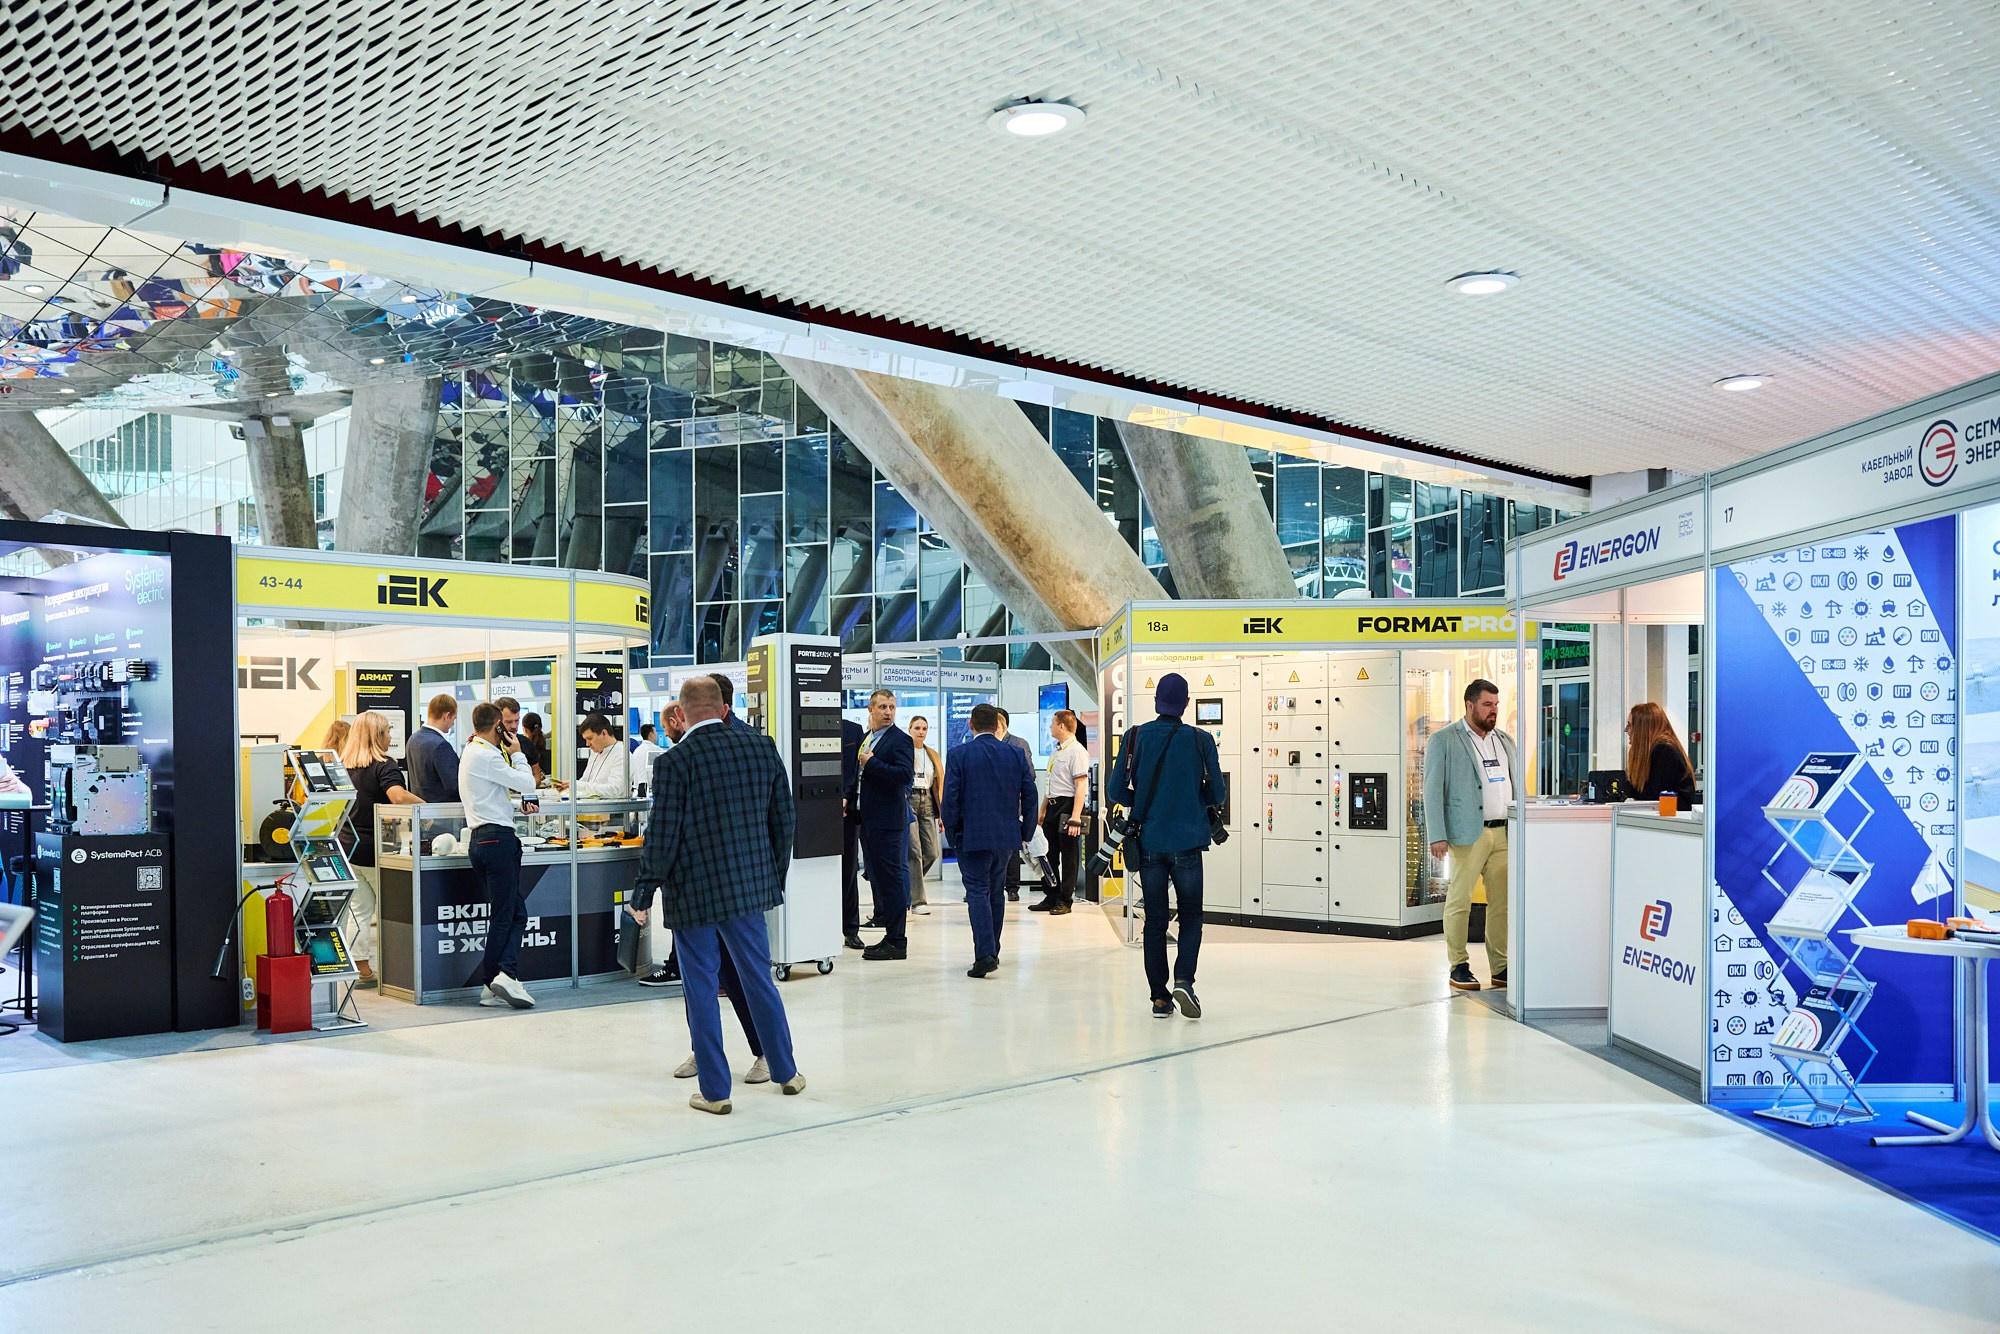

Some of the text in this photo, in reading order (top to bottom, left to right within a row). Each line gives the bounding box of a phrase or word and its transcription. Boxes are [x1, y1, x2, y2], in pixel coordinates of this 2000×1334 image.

[1861, 445, 1913, 474] КАБЕЛЬНЫЙ
[1883, 465, 1914, 483] ЗАВОД
[1724, 506, 1734, 523] 17
[1579, 526, 1661, 569] ENERGON
[1822, 548, 1845, 558] RS-485
[259, 576, 303, 590] 43-44
[1812, 576, 1829, 587] ОКЛ
[1895, 575, 1910, 586] UTP
[635, 594, 650, 624] iE
[1147, 621, 1169, 632] 18a
[1813, 631, 1828, 642] UTP
[1922, 630, 1938, 641] ОКЛ
[1822, 659, 1845, 669] RS-485
[359, 673, 393, 681] ARMAT
[576, 667, 598, 679] EK
[884, 668, 925, 676] СЛАБОТОЧНЫЕ
[491, 685, 516, 696] UBEZH
[1894, 686, 1910, 697] UTP
[1921, 742, 1938, 752] ОКЛ
[90, 848, 163, 860] SystemePact ACB
[437, 902, 492, 920] ВКЛ
[437, 916, 540, 937] ЧАЕЯ
[438, 931, 556, 955] В ЖНЬ!
[1622, 944, 1697, 987] ENERGON
[1729, 965, 1745, 976] ОКЛ
[1739, 1048, 1762, 1058] RS-485
